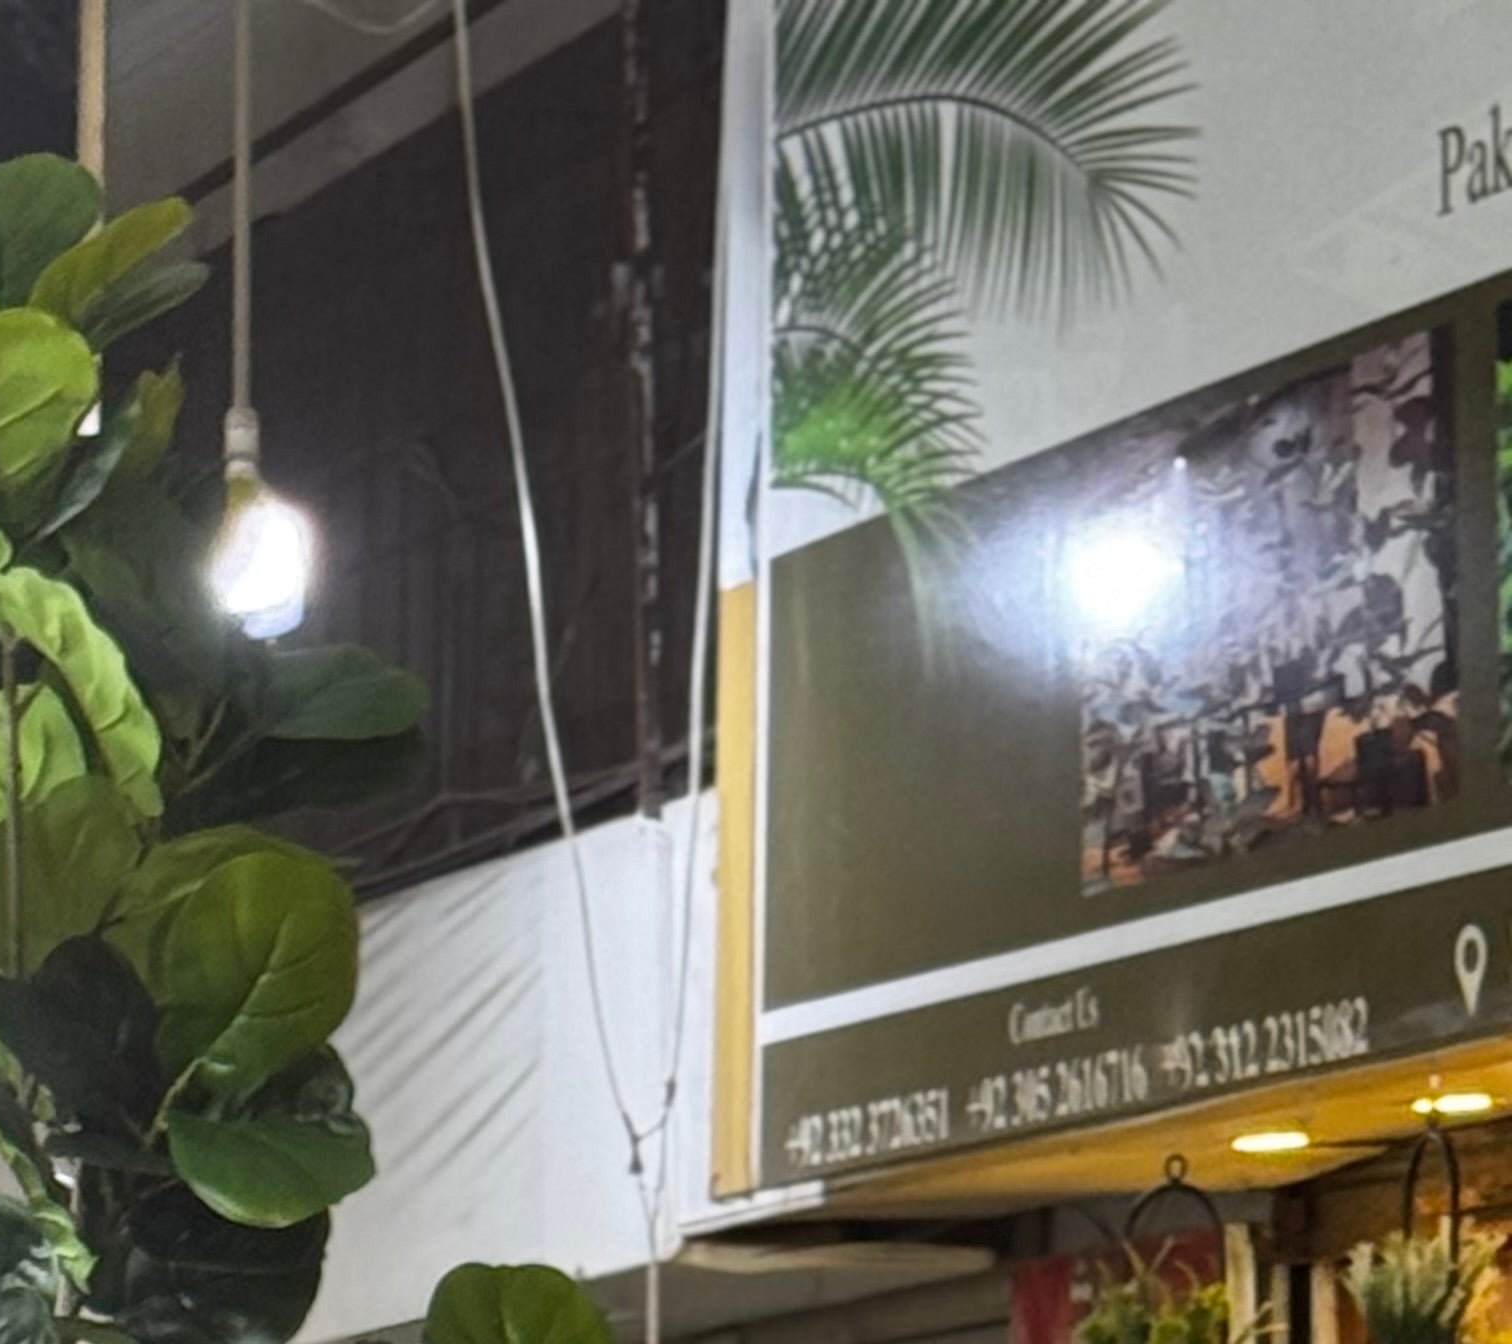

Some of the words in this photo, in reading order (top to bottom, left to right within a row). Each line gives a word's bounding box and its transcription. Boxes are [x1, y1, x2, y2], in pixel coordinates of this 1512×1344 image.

[1008, 1000, 1074, 1046] Contact
[1075, 985, 1099, 1031] Us
[965, 1073, 1008, 1132] +92
[1160, 1030, 1210, 1091] +92
[1211, 1018, 1260, 1085] 312
